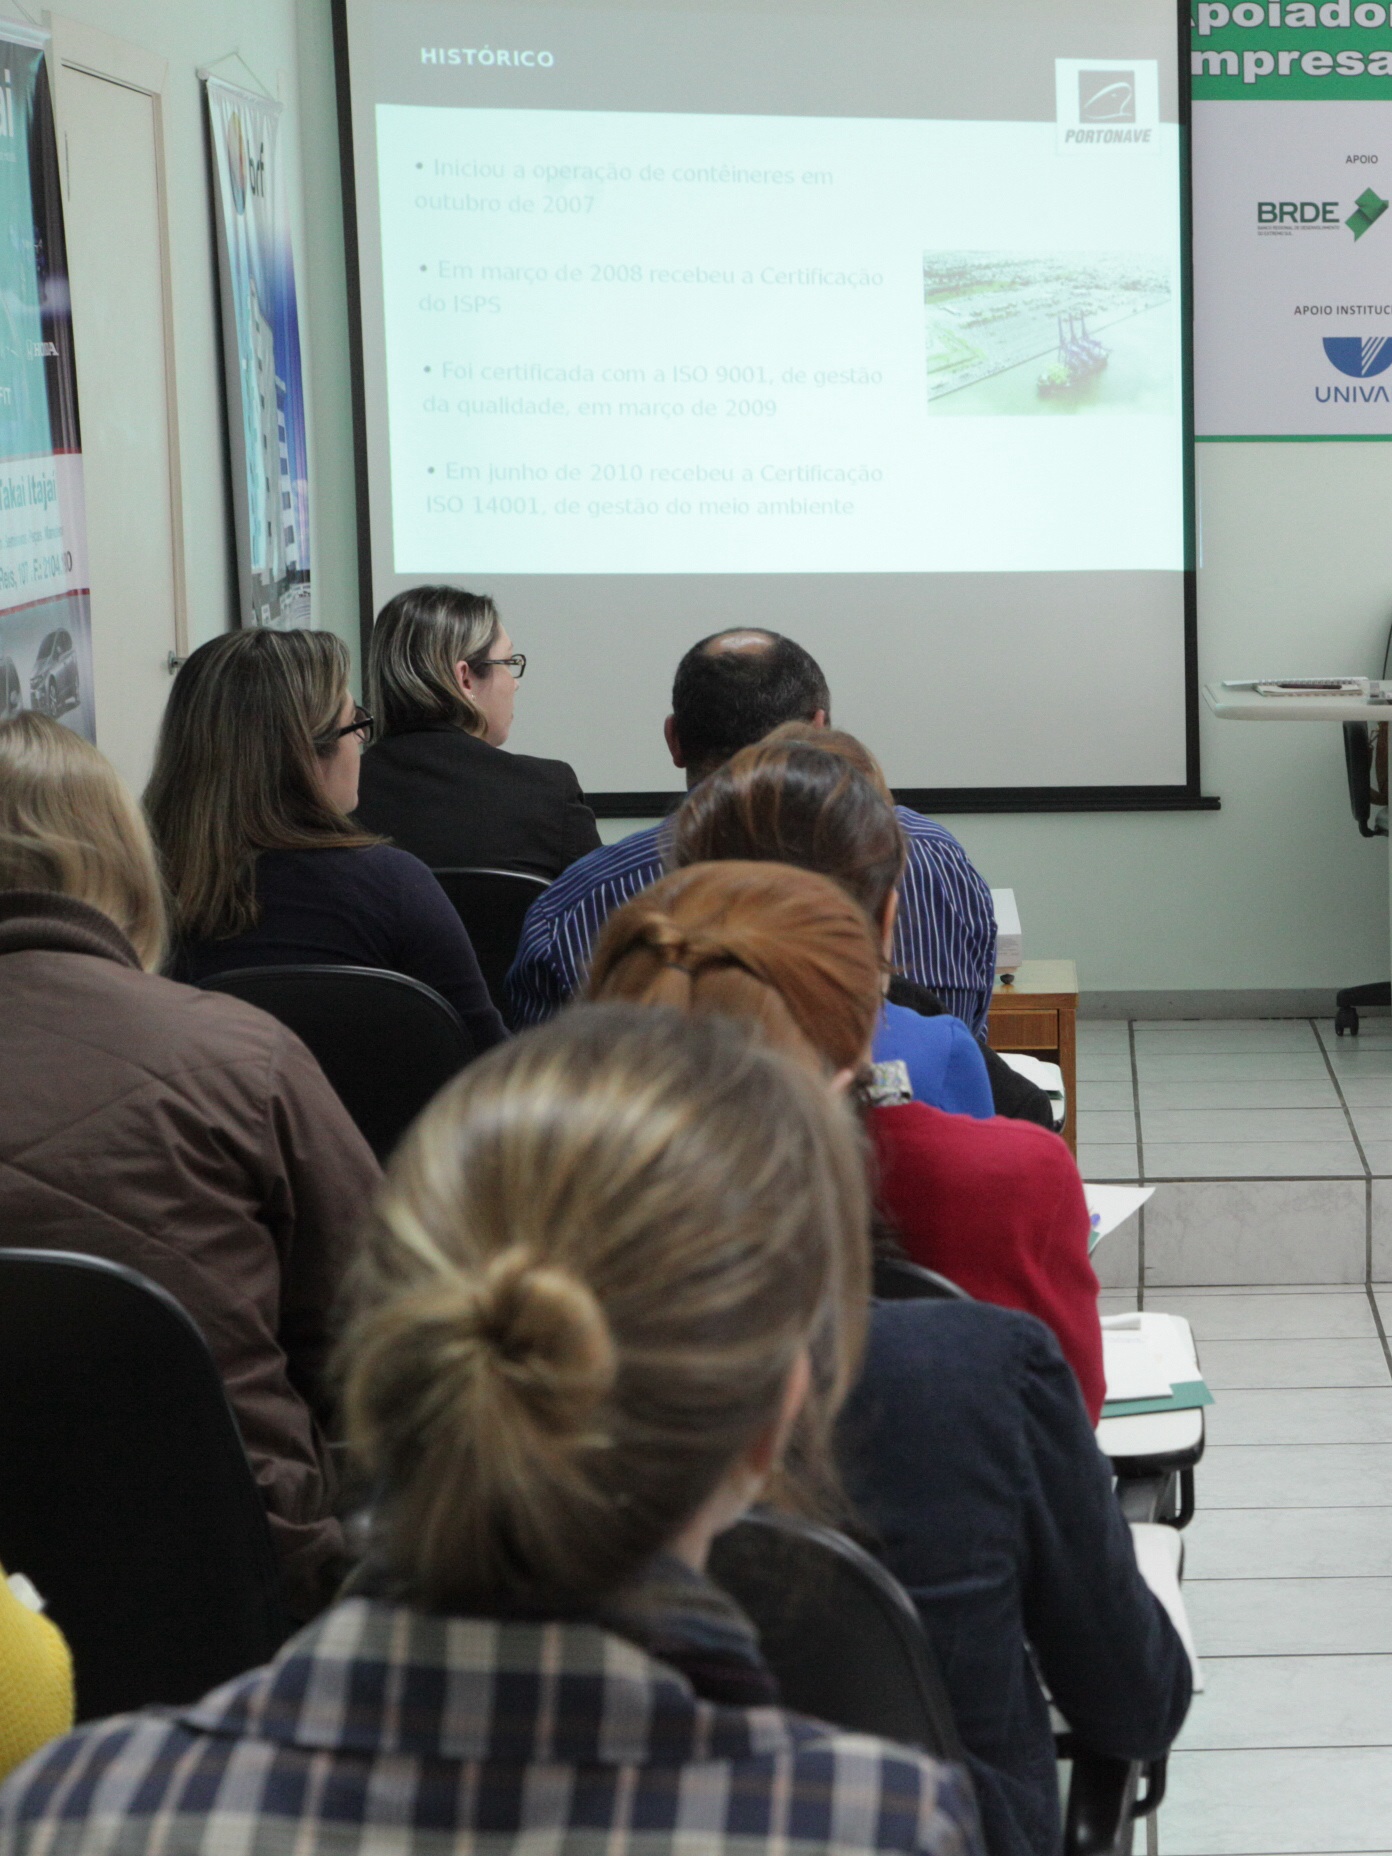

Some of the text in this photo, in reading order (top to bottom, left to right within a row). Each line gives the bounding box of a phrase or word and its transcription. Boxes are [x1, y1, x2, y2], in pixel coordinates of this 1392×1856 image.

[420, 44, 554, 68] HISTÓRICO
[1065, 129, 1152, 144] PORTONAVE
[1345, 155, 1379, 164] APOIO
[433, 159, 834, 185] Iniciou a operação de contêineres em
[414, 192, 595, 214] outubro de 2007
[1257, 202, 1340, 223] BRDE
[438, 260, 884, 289] Em março de 2008 recebeu a Certificação
[418, 293, 502, 314] do ISPS
[1294, 305, 1333, 315] APOIO
[442, 361, 883, 388] Foi certificada com a ISO 9001, de gestão
[422, 395, 778, 420] da qualidade, em março de 2009
[446, 462, 883, 486] Em junho de 2010 recebeu a Certificação
[426, 495, 855, 519] ISO 14001, de gestão do meio ambiente
